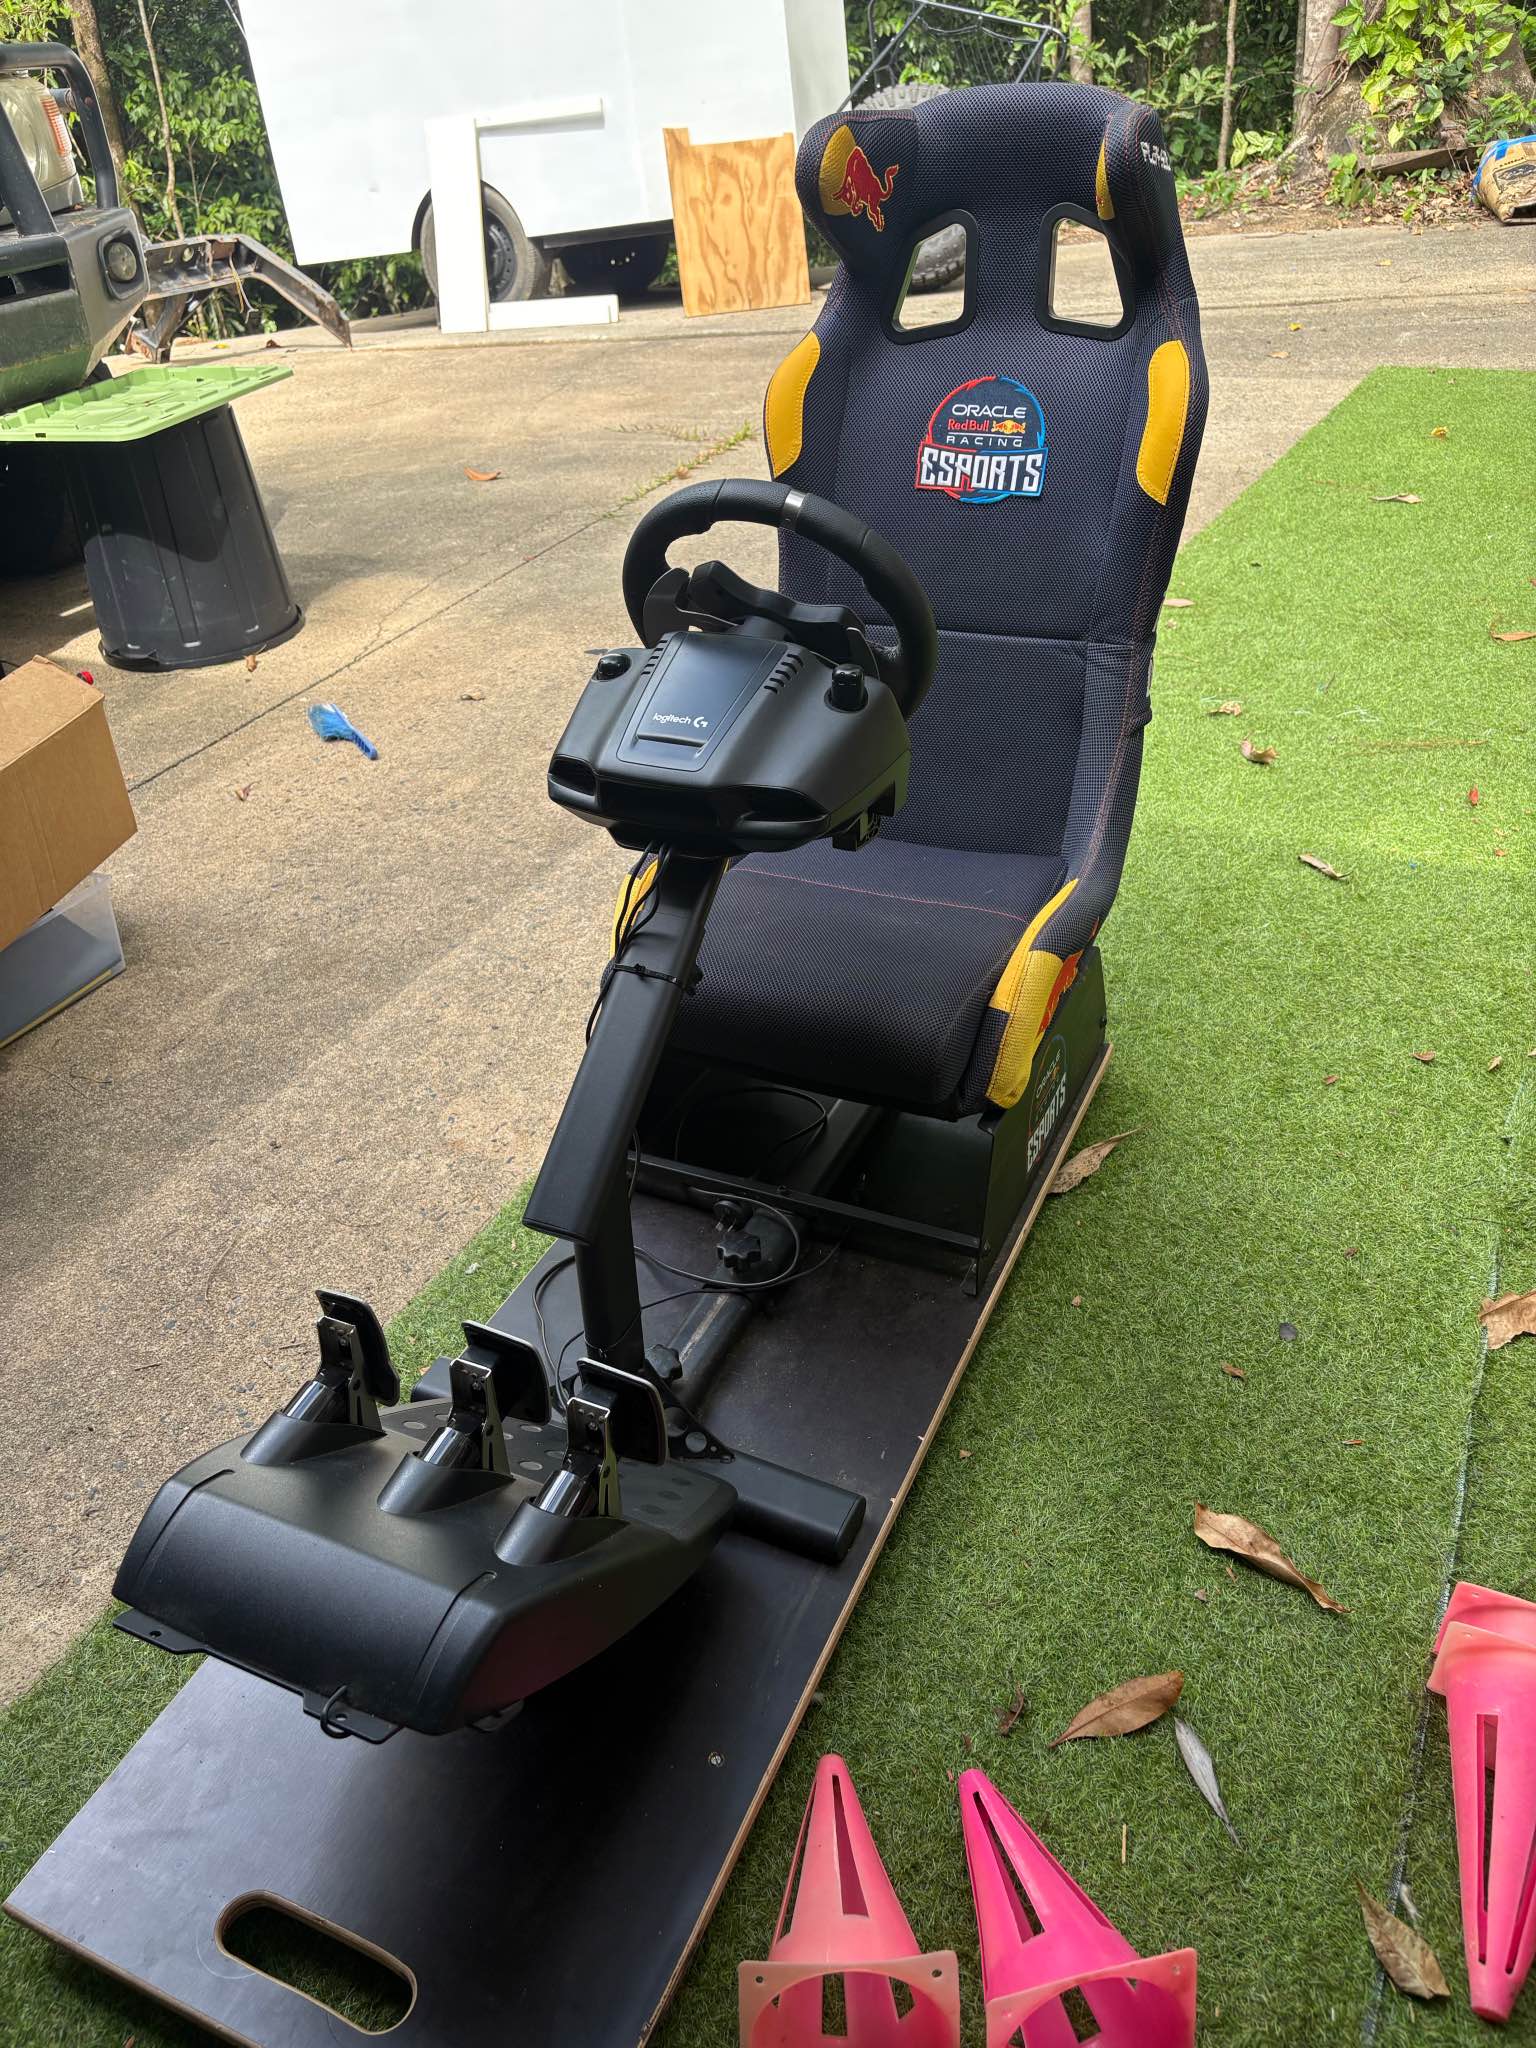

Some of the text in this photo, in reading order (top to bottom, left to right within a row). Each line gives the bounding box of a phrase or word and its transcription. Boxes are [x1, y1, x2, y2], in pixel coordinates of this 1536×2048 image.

[952, 404, 1027, 419] ORACLE
[946, 436, 1023, 448] RACING
[920, 447, 1043, 492] ESPORTS
[652, 712, 691, 725] logitech
[1027, 1072, 1067, 1173] ESPORTS
